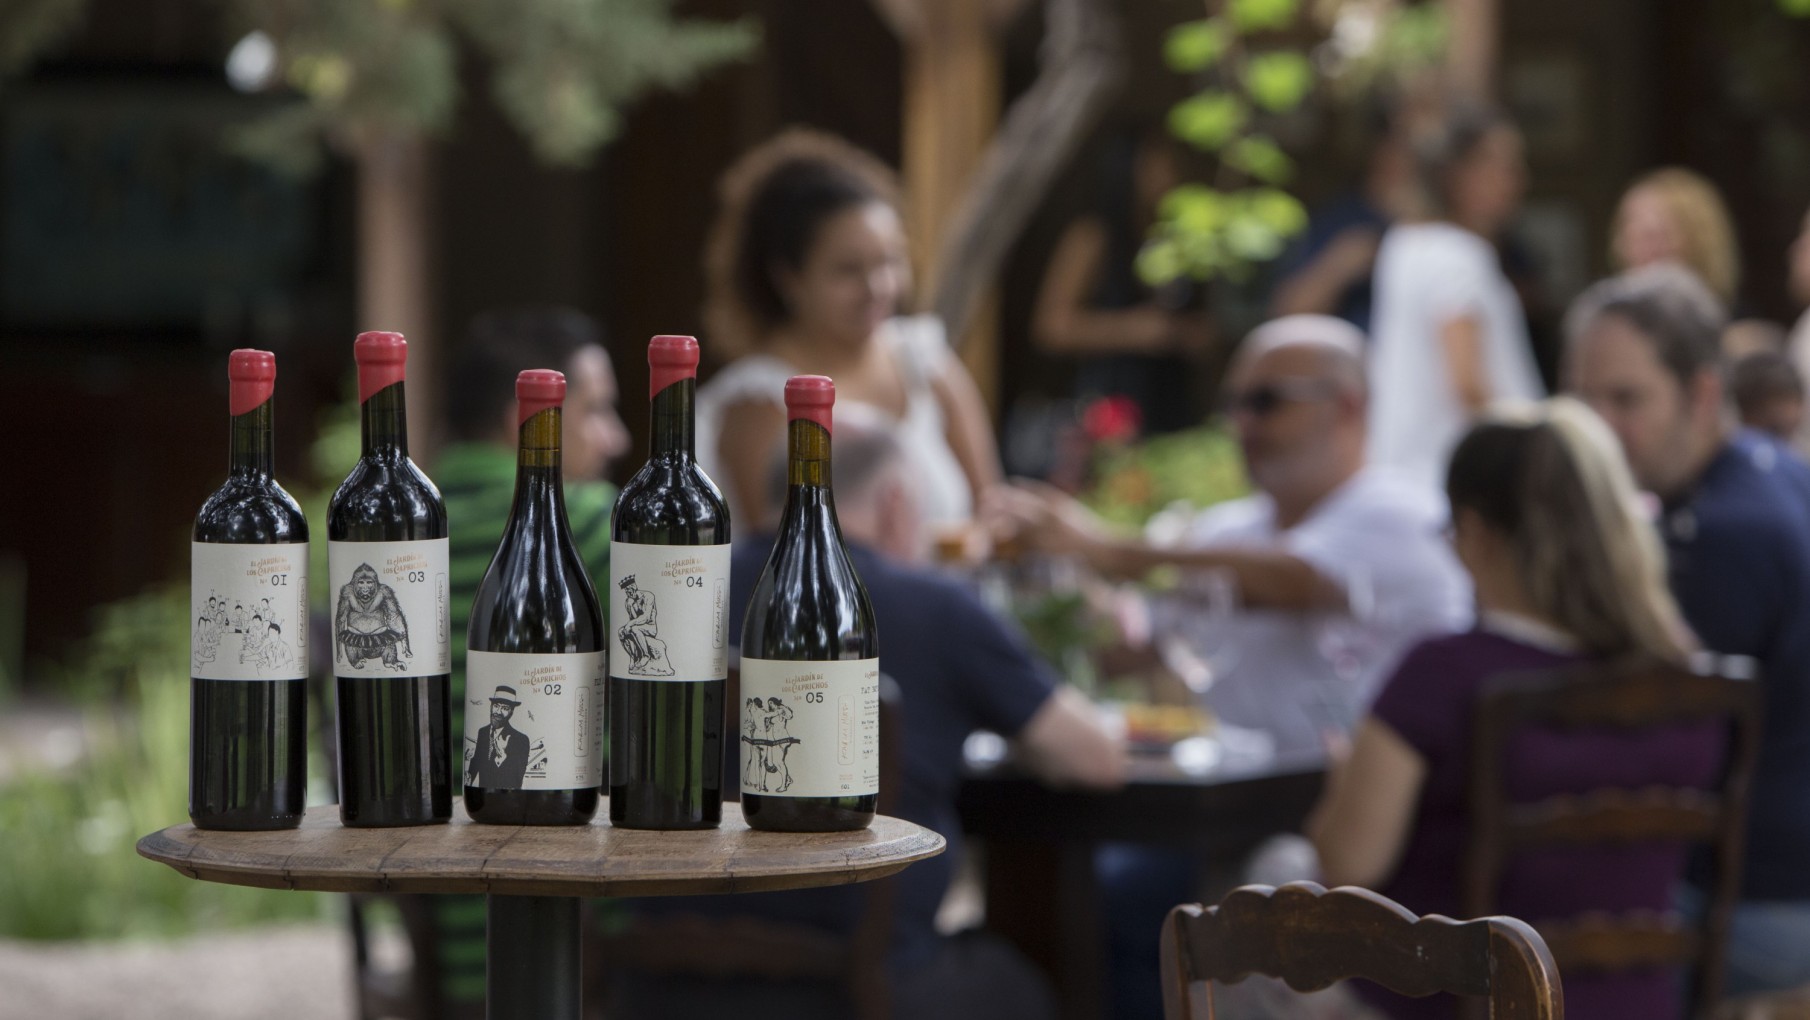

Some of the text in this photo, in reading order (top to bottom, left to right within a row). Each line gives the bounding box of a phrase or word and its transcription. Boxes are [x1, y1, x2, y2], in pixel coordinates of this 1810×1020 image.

[408, 571, 425, 583] 03
[686, 576, 703, 588] 04
[544, 684, 562, 696] 02
[806, 692, 824, 704] 05
